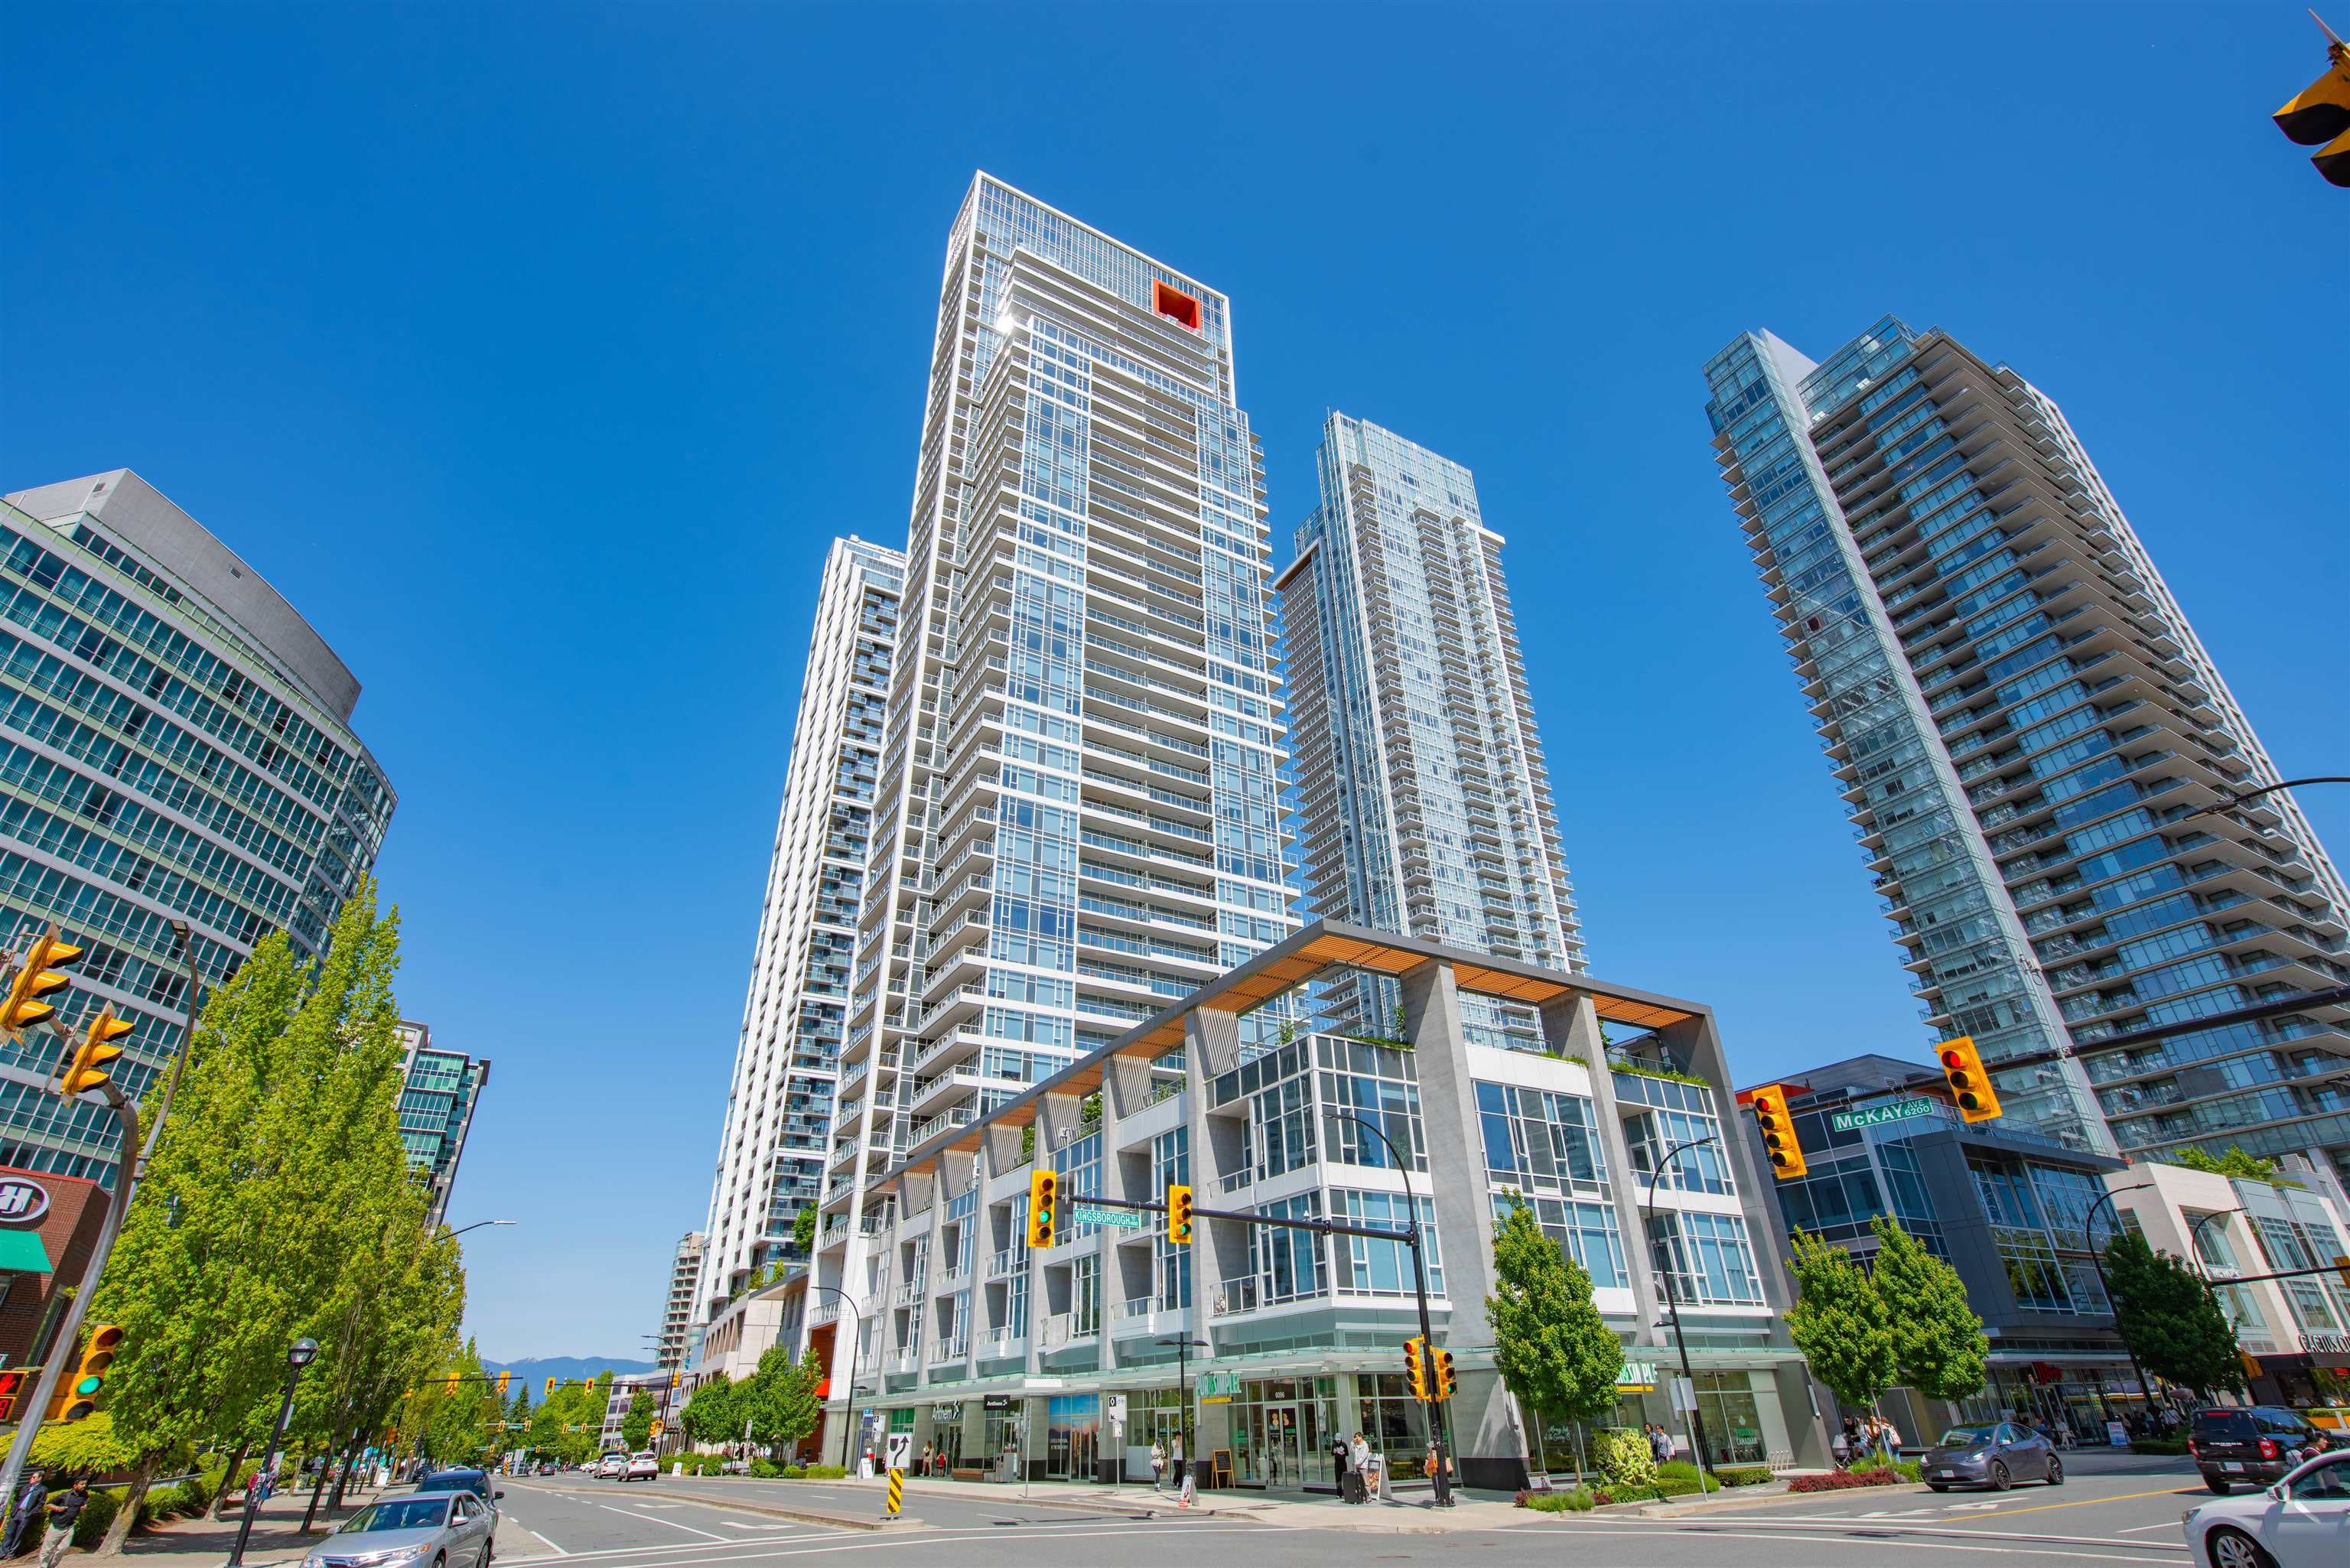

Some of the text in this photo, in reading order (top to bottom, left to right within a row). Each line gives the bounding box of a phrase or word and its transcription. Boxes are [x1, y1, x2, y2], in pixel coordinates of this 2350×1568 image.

[1836, 1100, 1925, 1129] McKAY AVE
[1905, 1105, 1929, 1116] 6200
[1075, 1211, 1131, 1225] KINGSBOROUGH
[2300, 1335, 2338, 1353] CACTUS
[932, 1402, 952, 1420] Anthem
[1736, 1437, 1758, 1446] CANADIAN
